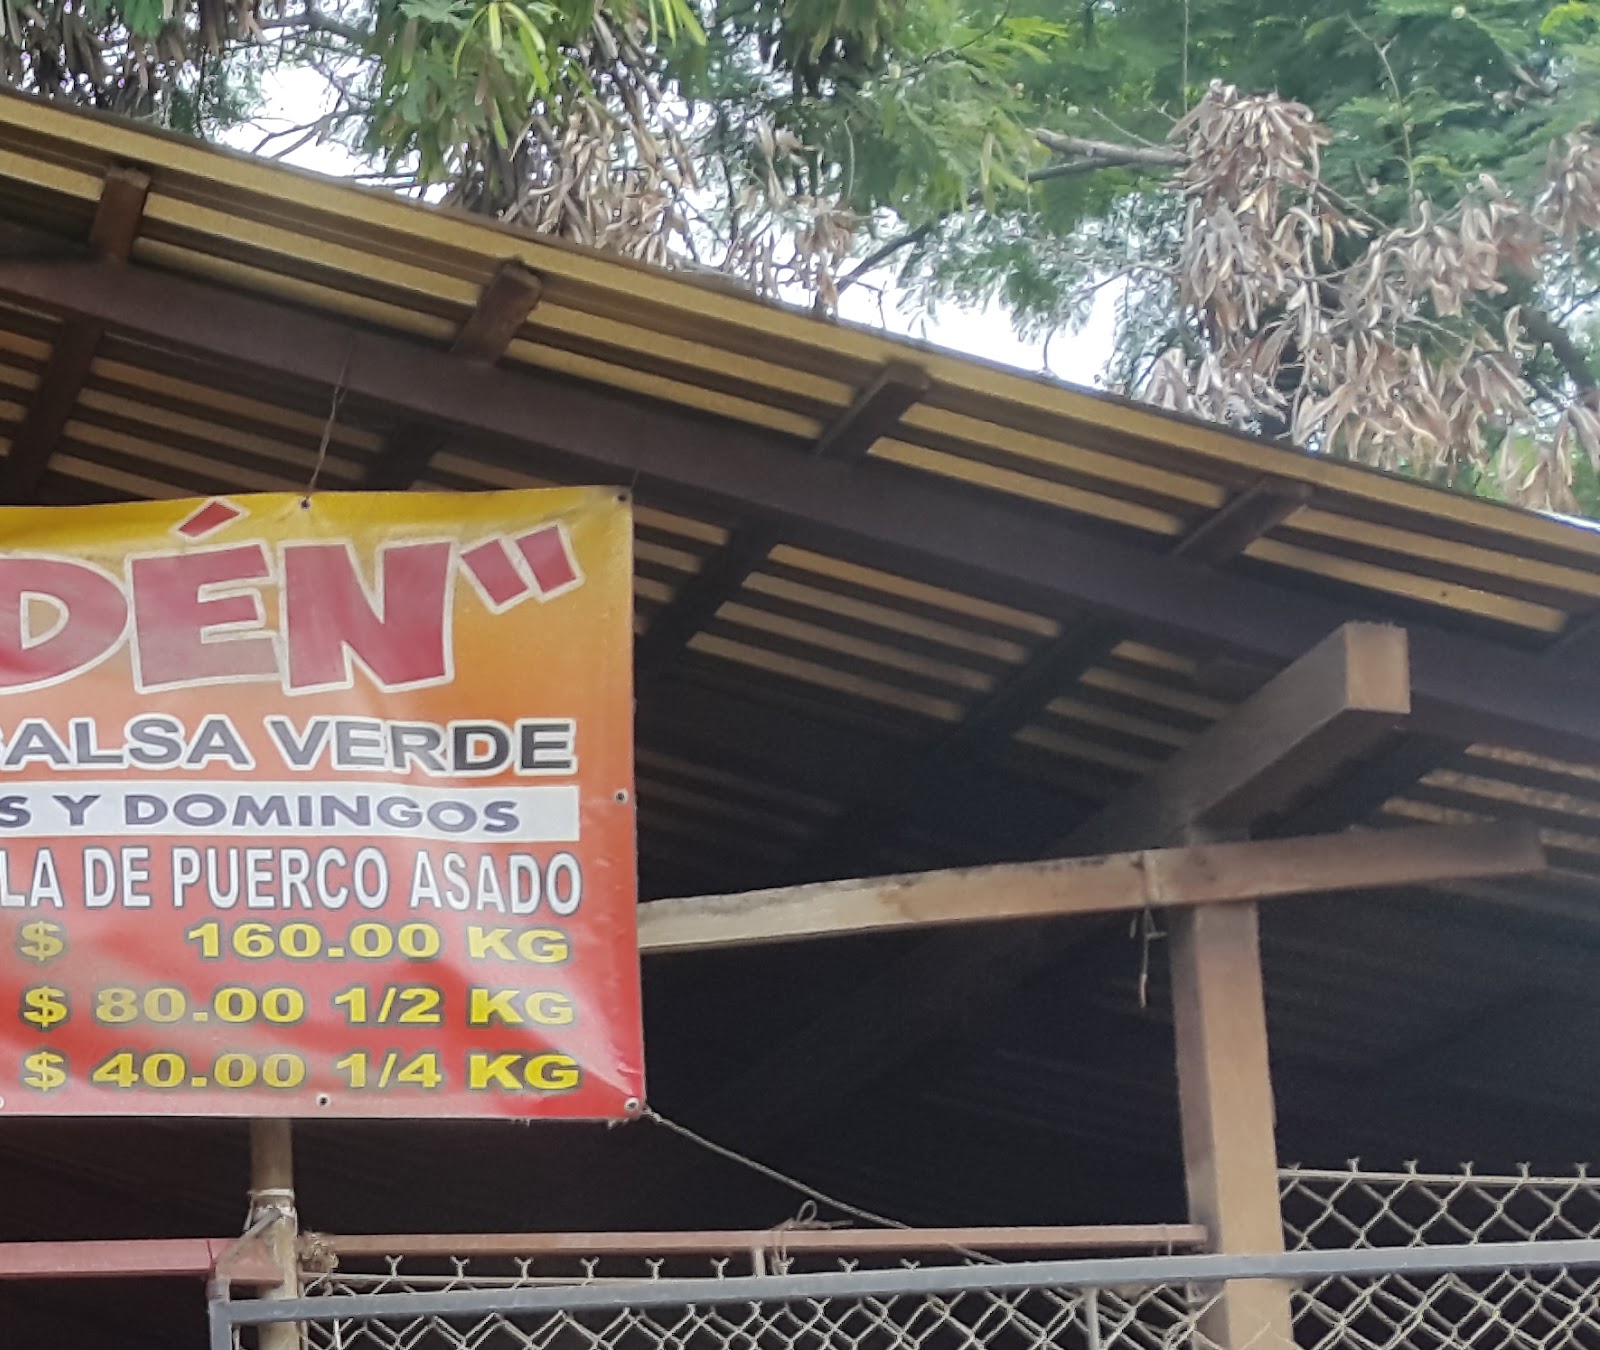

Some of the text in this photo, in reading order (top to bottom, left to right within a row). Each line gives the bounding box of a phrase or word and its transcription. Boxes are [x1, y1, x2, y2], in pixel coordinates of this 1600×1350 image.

[264, 714, 576, 776] VERDE
[53, 794, 101, 827] Y
[124, 794, 520, 833] DOMINGOS
[83, 845, 151, 909] DE
[170, 846, 390, 910] PUERCO
[409, 849, 582, 916] ASADO
[186, 920, 442, 961] 160.00
[465, 924, 571, 965] KG
[94, 985, 306, 1026] 80.00
[332, 986, 442, 1026] 1/2
[467, 987, 576, 1026] KG
[91, 1051, 306, 1091] 40.00
[334, 1051, 442, 1090] 1/4
[468, 1052, 580, 1091] KG
